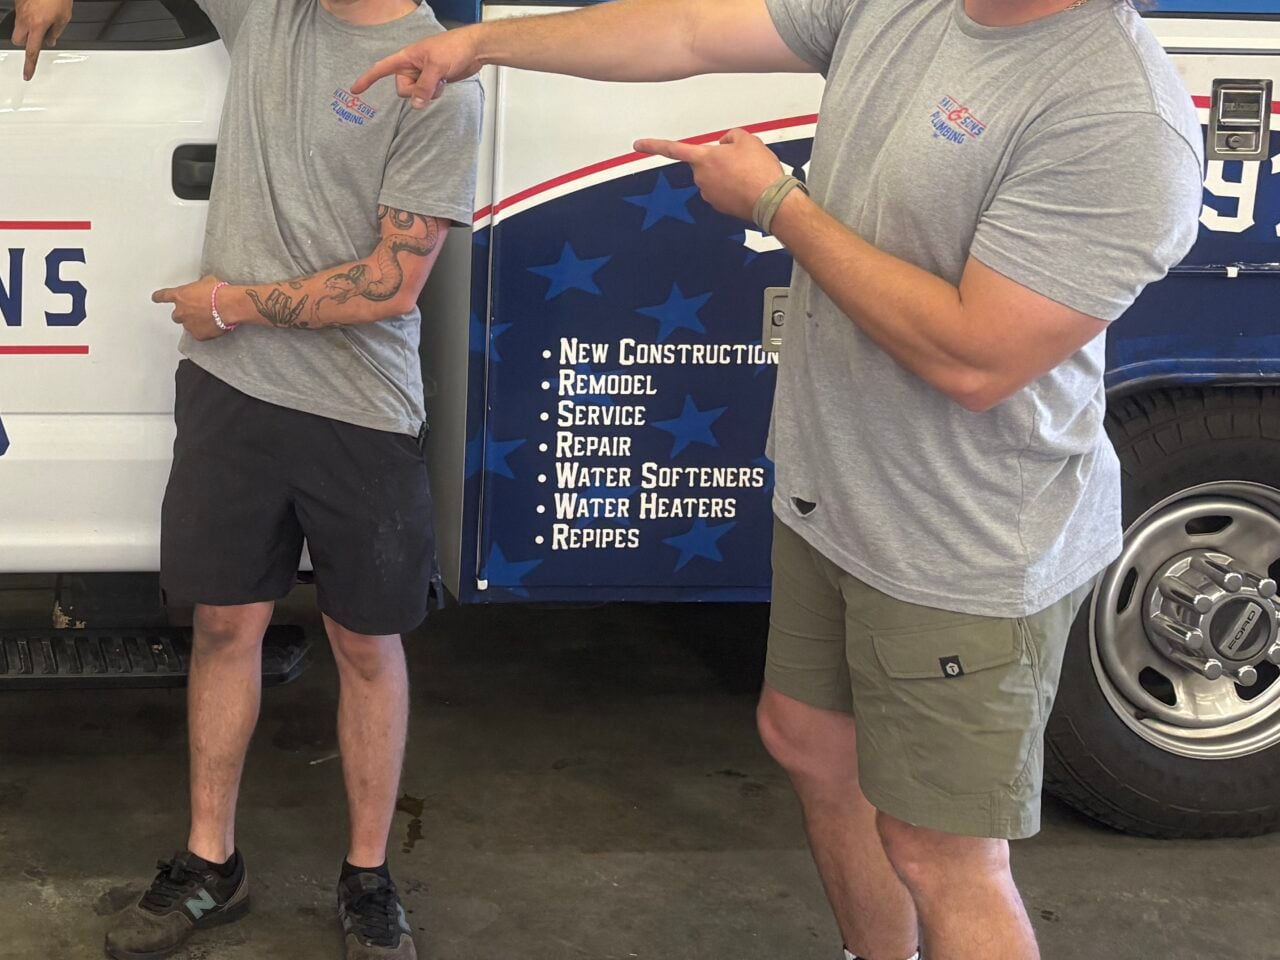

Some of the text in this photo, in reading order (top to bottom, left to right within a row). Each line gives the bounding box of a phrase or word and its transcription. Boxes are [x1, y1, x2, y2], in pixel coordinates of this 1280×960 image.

[559, 337, 608, 366] NEW
[558, 369, 658, 397] REMODEL
[556, 400, 646, 427] SERVICE
[555, 431, 632, 459] REPAIR
[554, 462, 765, 490] WATER SOFTENERS
[553, 493, 737, 520] WATER HEATERS
[551, 524, 640, 550] REPIPES
[1227, 610, 1256, 650] FORD
[185, 889, 218, 920] N
